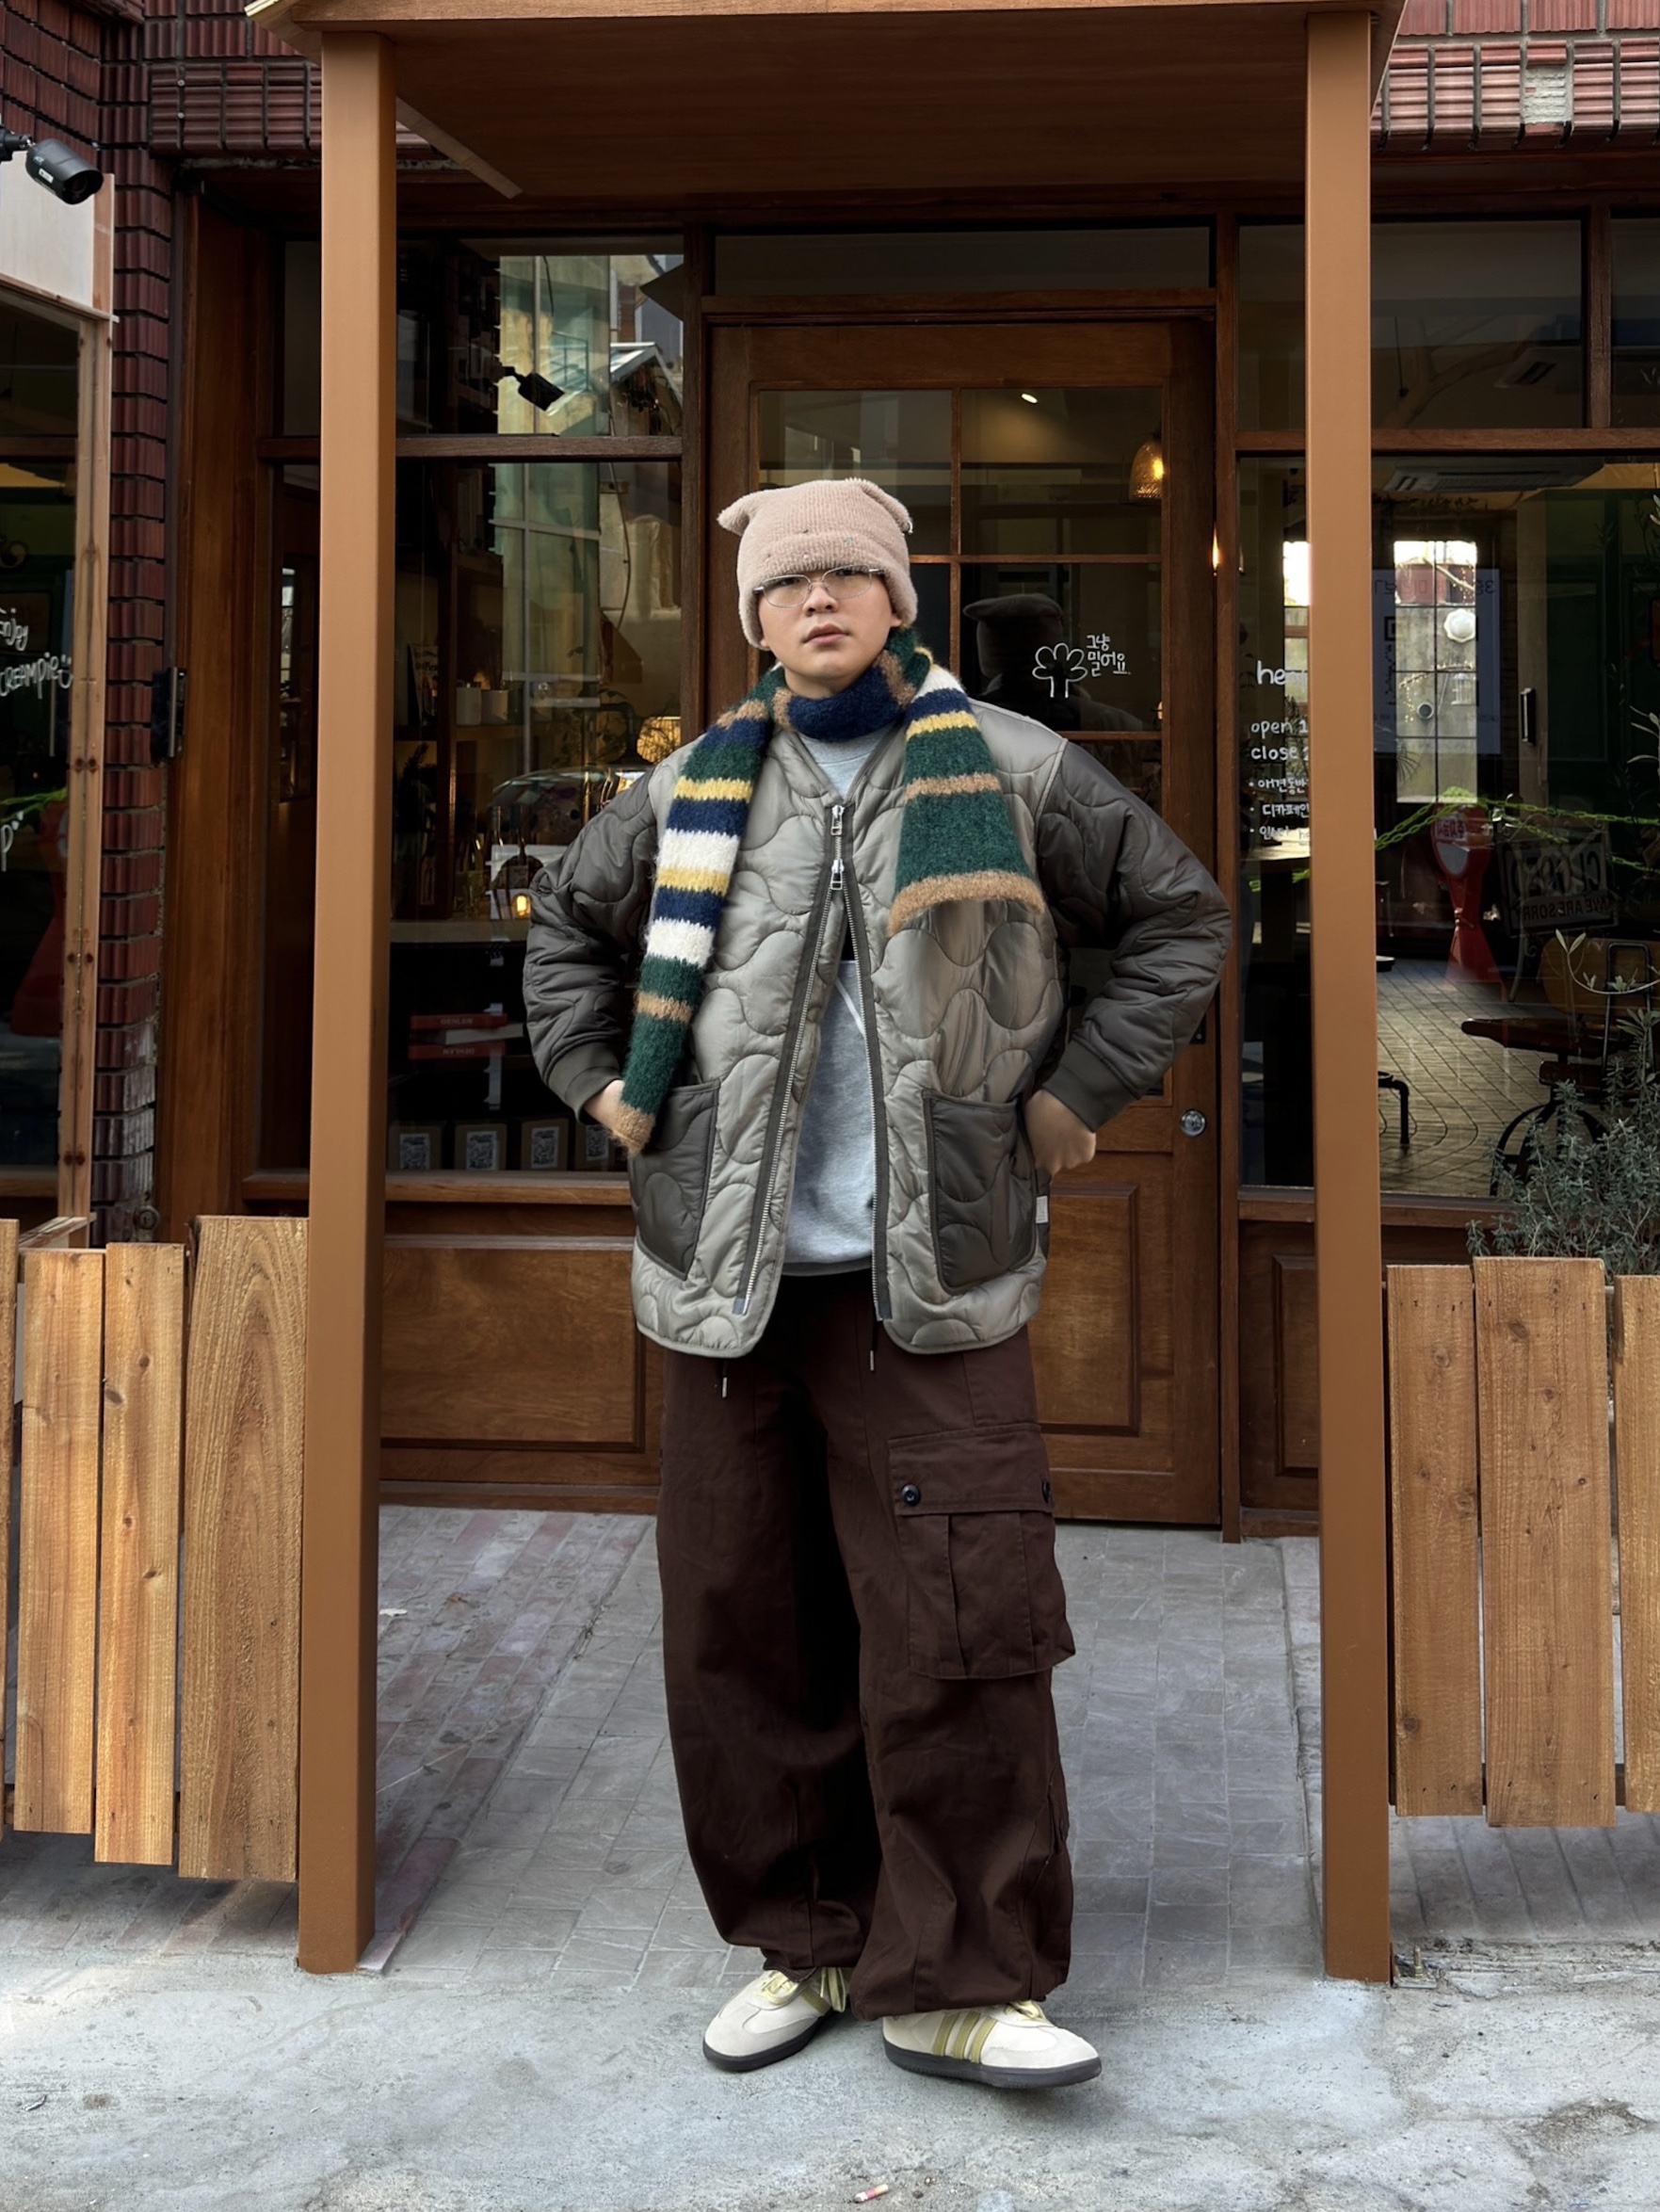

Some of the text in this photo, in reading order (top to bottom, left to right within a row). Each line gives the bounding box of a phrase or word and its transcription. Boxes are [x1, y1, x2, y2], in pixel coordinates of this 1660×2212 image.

[1086, 633, 1111, 652] 그냥
[1250, 719, 1294, 739] open
[1250, 745, 1297, 761] close
